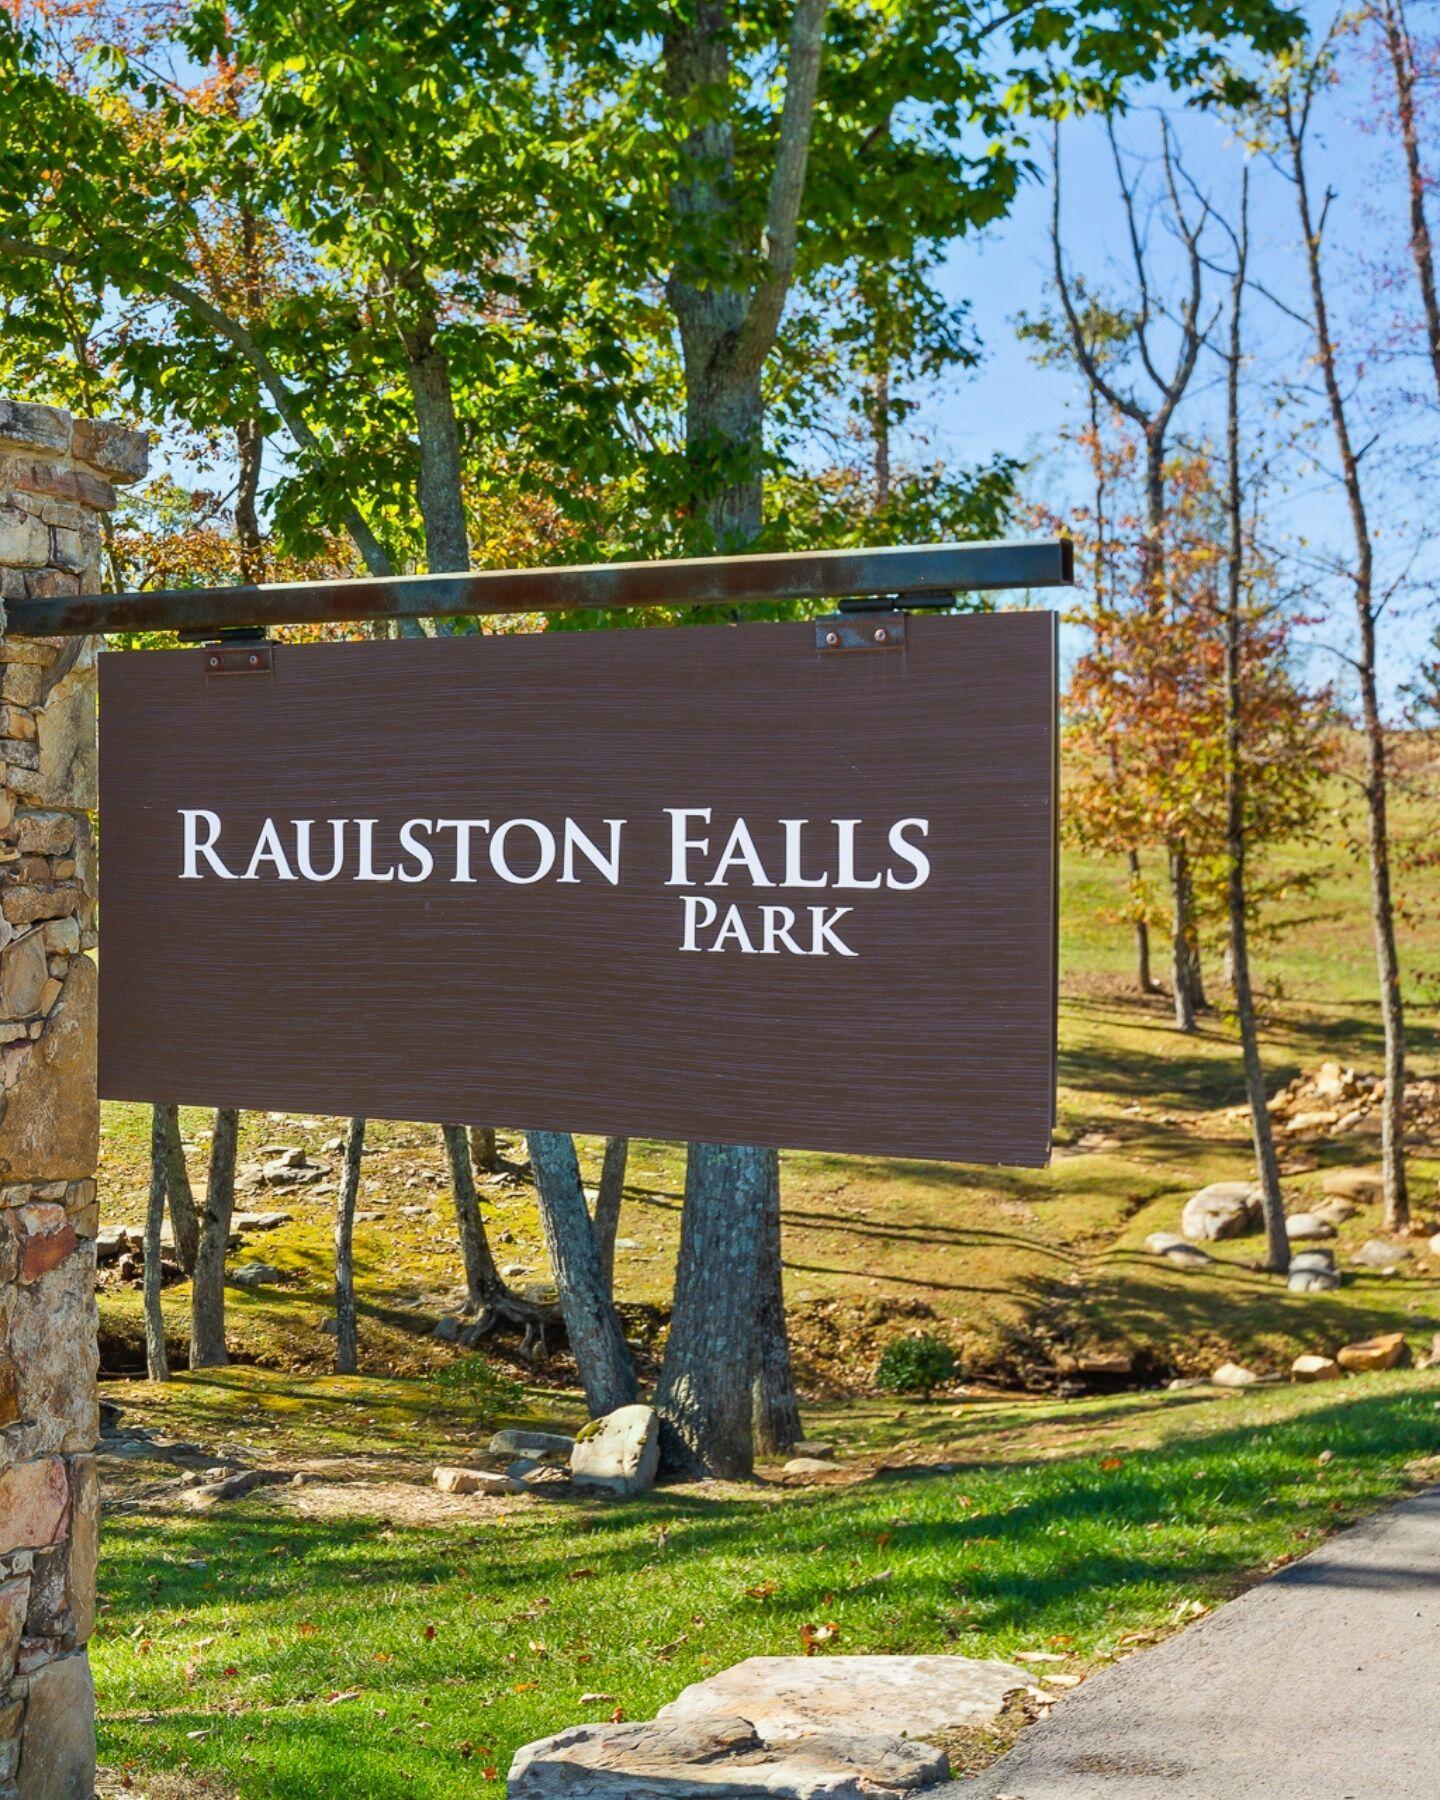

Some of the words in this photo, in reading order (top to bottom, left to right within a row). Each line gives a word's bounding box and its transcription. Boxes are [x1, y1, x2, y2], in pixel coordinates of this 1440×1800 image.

[176, 808, 628, 886] RAULSTON
[662, 807, 931, 891] FALLS
[678, 895, 859, 957] PARK
